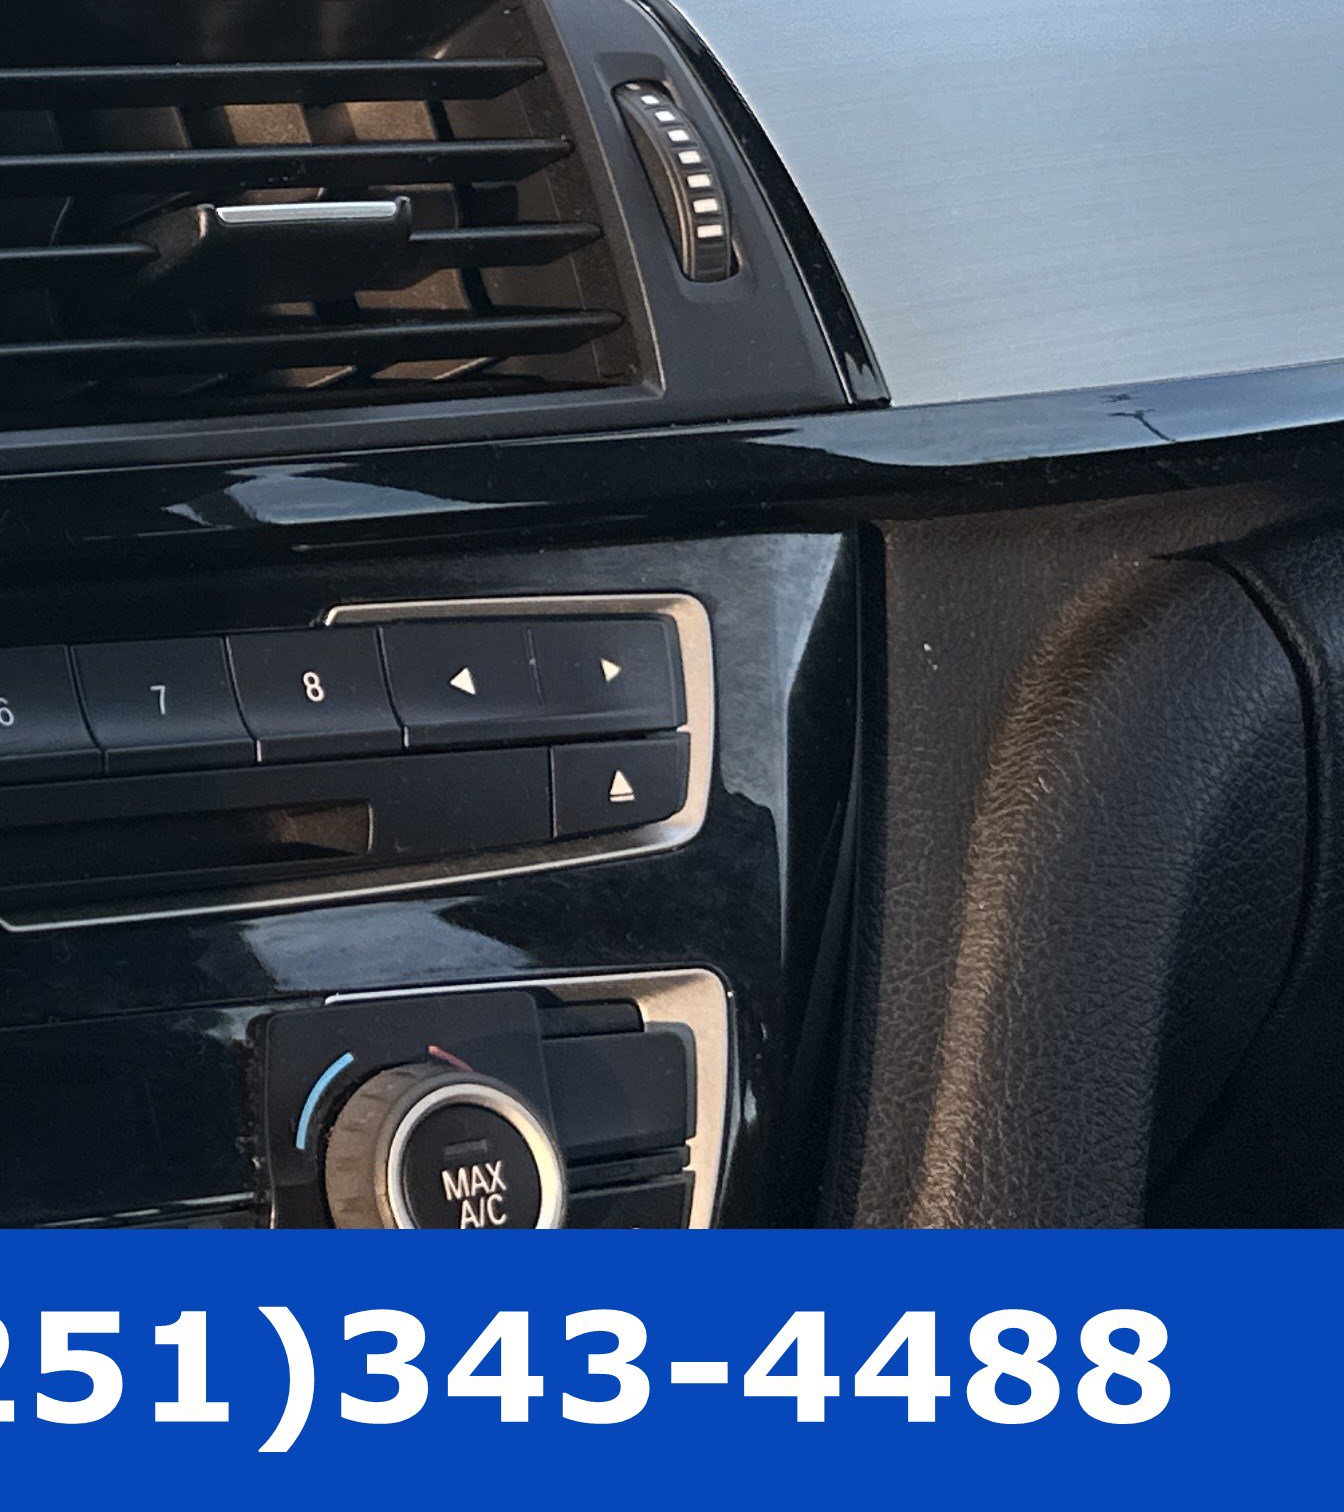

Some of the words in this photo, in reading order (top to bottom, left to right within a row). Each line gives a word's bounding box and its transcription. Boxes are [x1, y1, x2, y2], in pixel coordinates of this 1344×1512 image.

[150, 685, 167, 715] 7
[303, 671, 325, 702] 8
[441, 1160, 508, 1202] MAX
[460, 1194, 508, 1229] A/C
